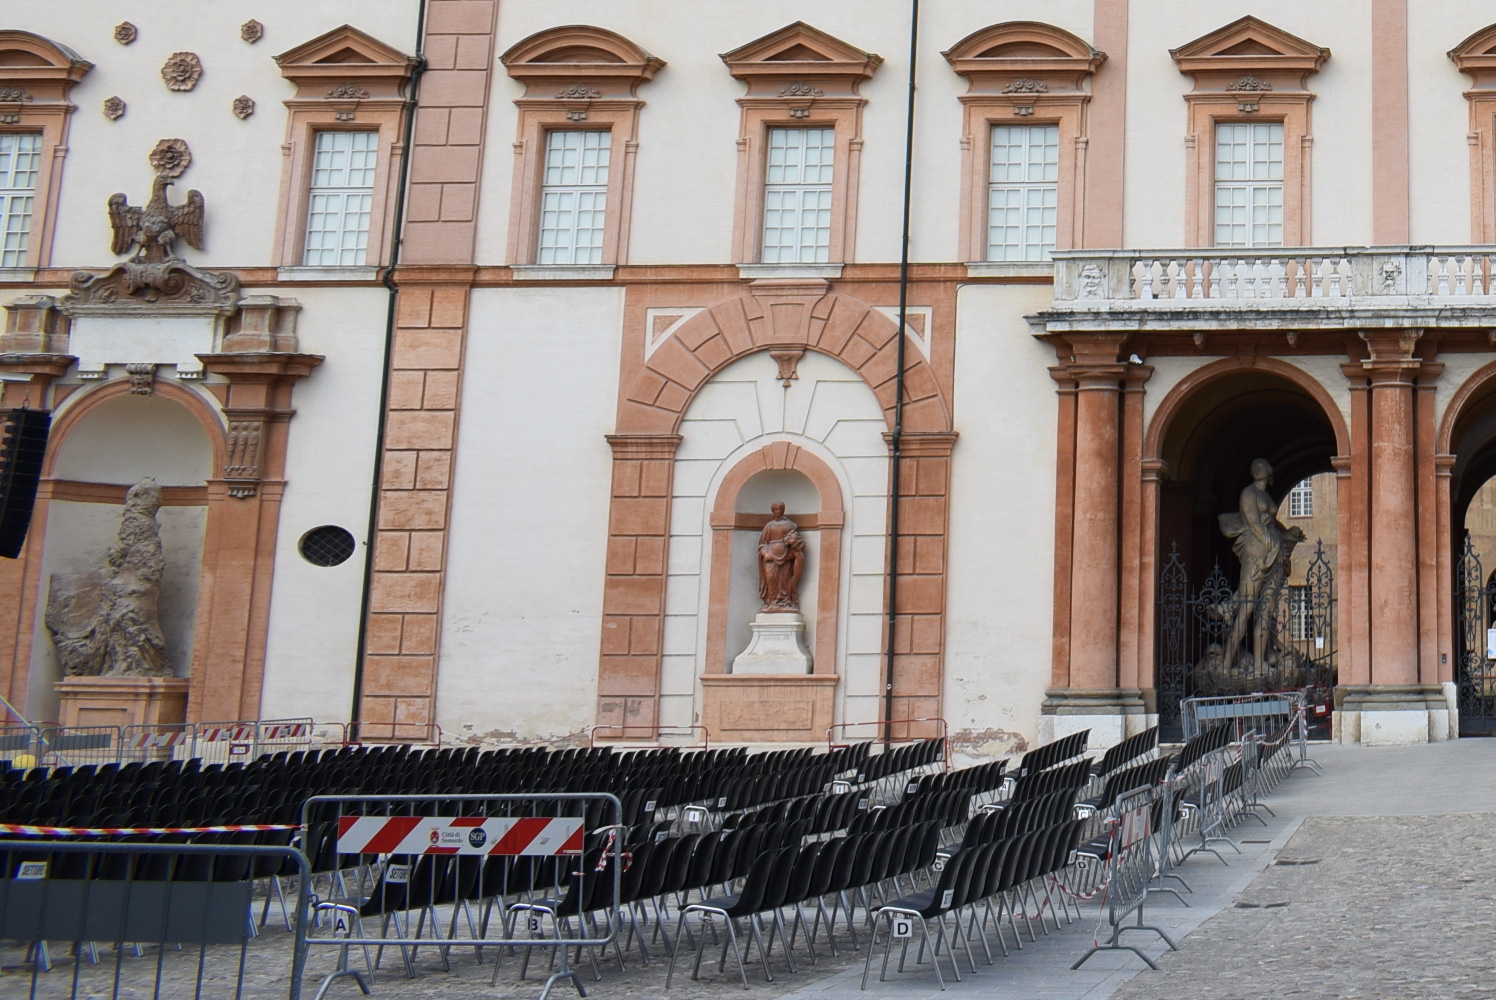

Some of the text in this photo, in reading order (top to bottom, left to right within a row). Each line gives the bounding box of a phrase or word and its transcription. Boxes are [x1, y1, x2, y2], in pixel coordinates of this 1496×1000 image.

[470, 832, 485, 841] SGP
[934, 862, 943, 870] C
[335, 918, 347, 931] A
[527, 917, 539, 931] B
[897, 922, 909, 936] D
